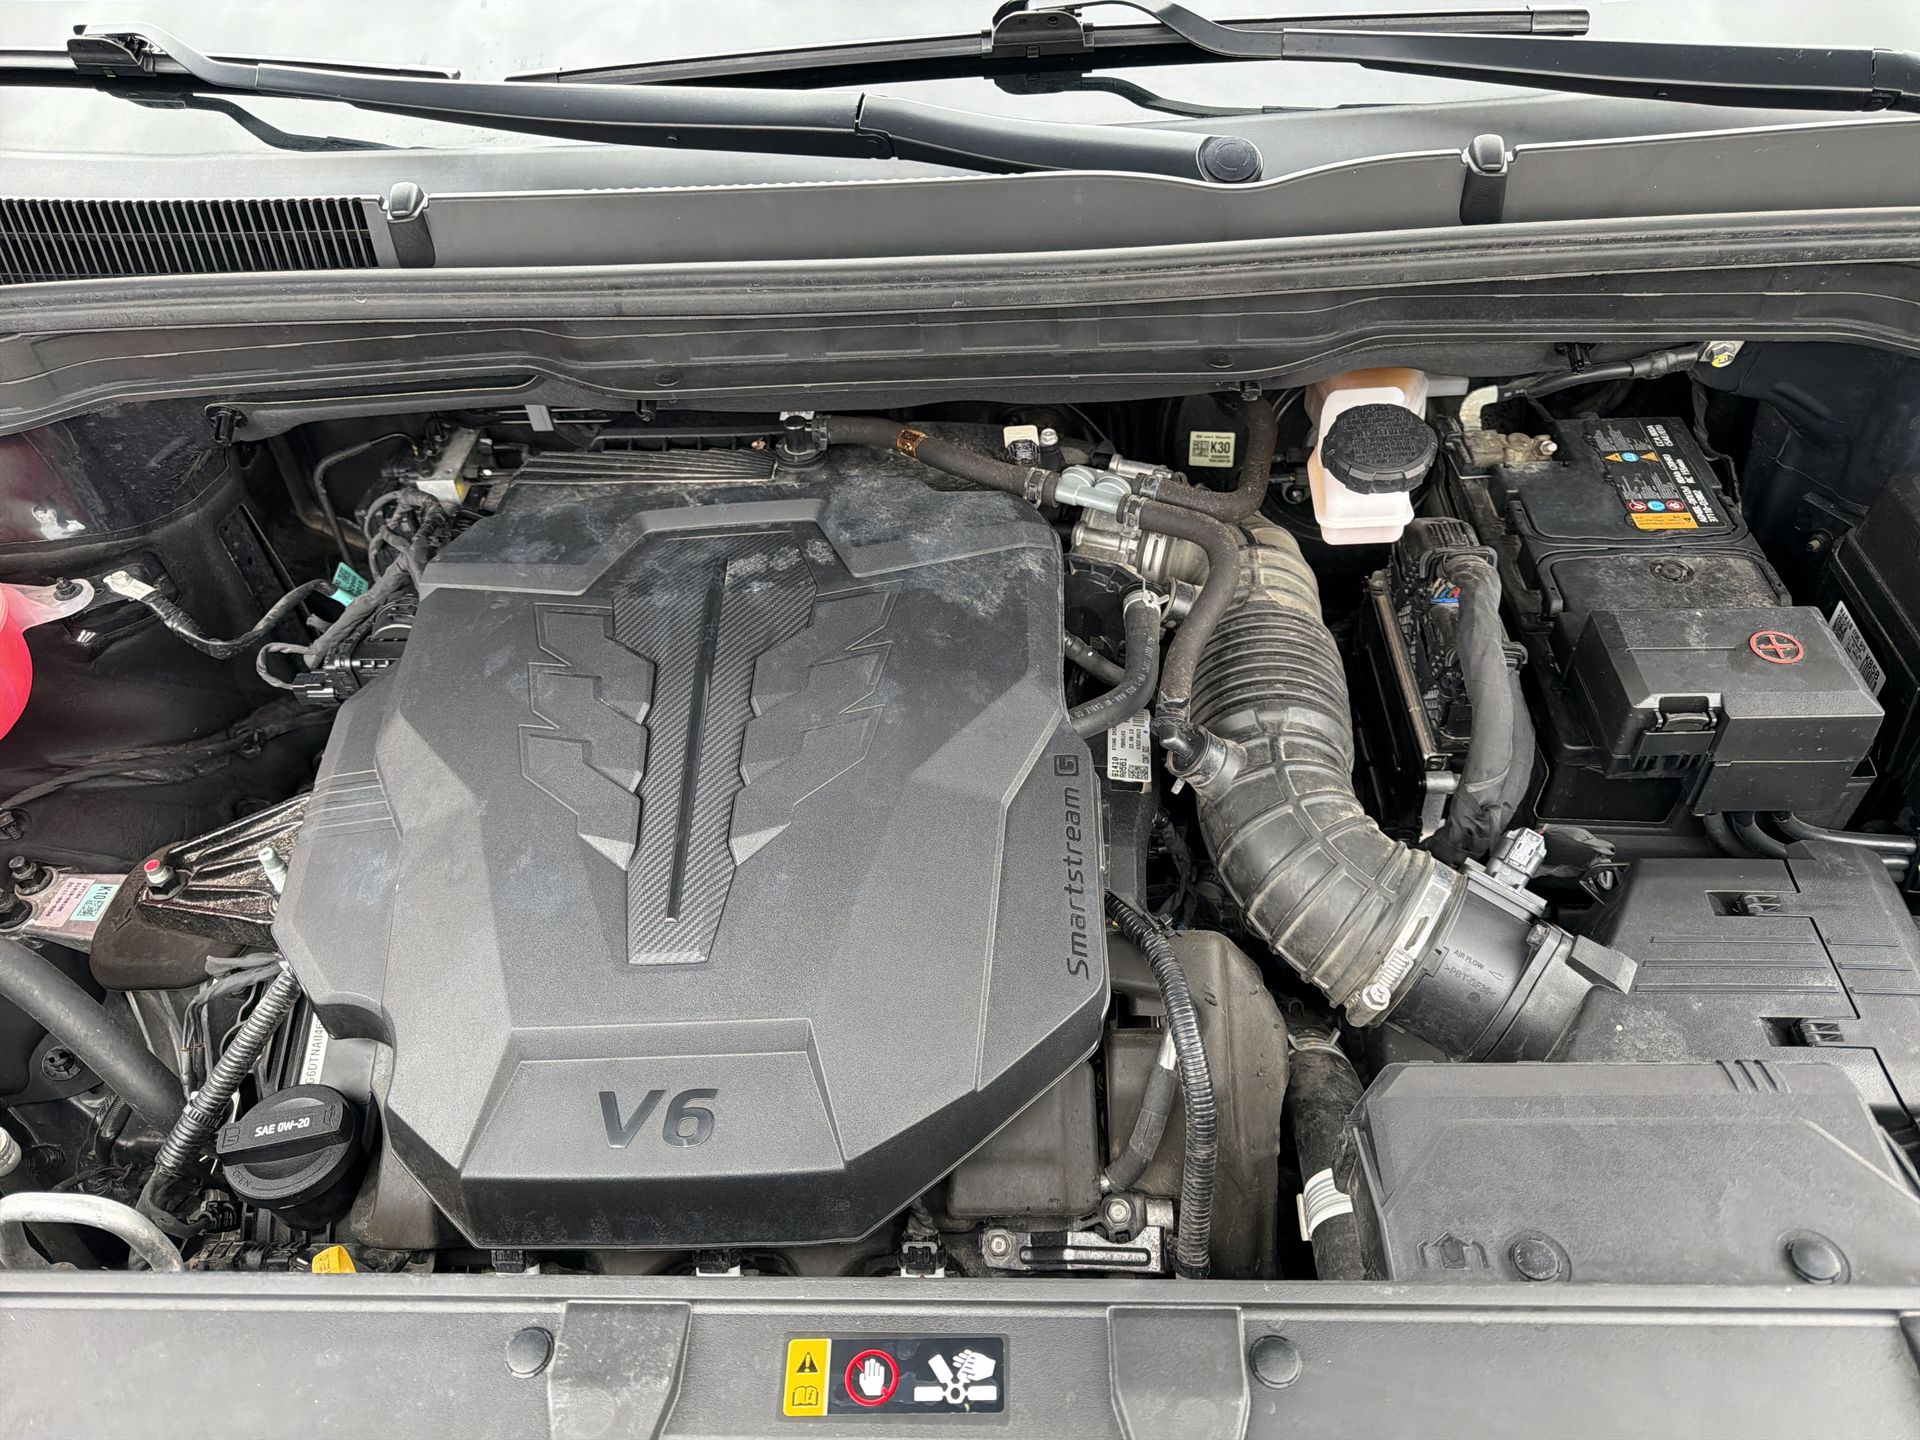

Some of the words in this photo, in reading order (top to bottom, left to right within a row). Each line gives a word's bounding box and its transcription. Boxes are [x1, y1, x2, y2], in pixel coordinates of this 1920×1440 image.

[1210, 441, 1231, 454] K30
[1111, 756, 1119, 777] 91410
[1119, 757, 1127, 778] R0561
[93, 885, 113, 900] K10
[1061, 786, 1090, 980] Smartstream
[1453, 949, 1466, 960] AIR
[1465, 955, 1485, 970] FLOW
[254, 1122, 276, 1138] SAE
[277, 1116, 311, 1133] 0W-20
[598, 1088, 719, 1149] V6
[231, 1169, 252, 1187] OPEN
